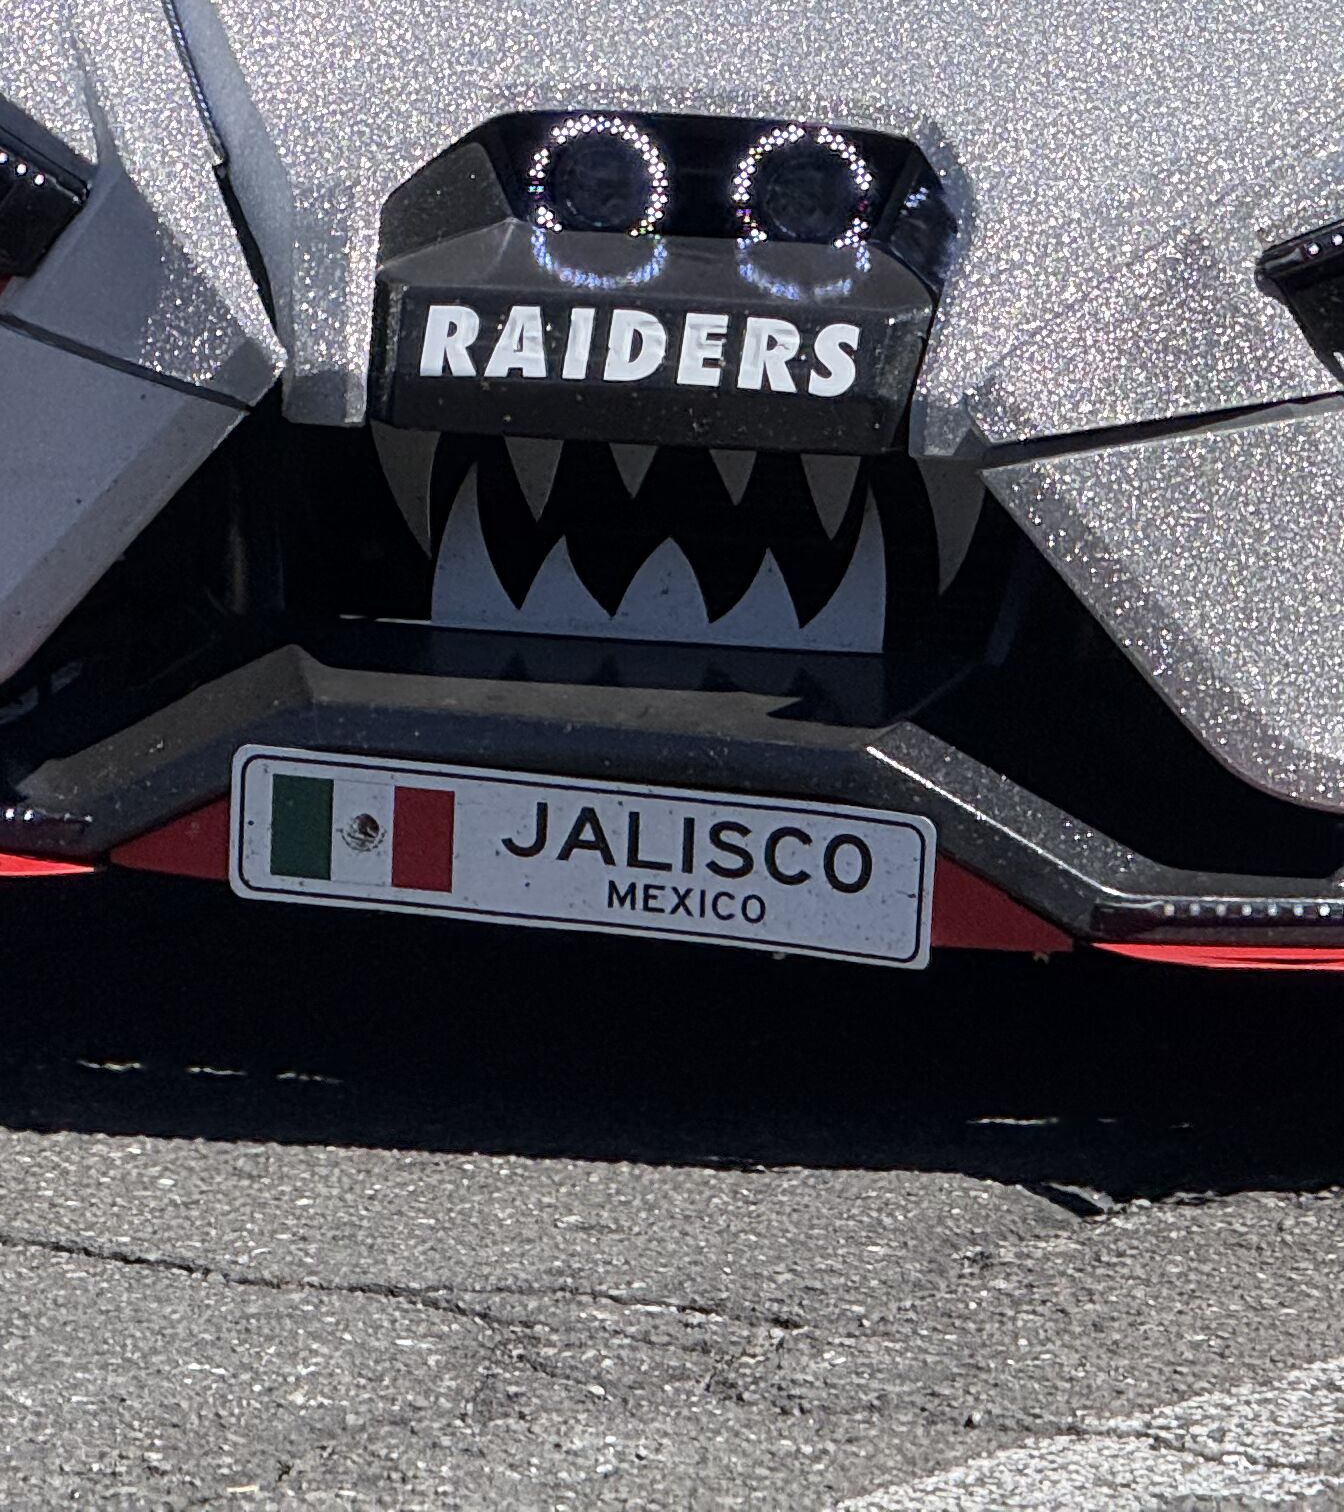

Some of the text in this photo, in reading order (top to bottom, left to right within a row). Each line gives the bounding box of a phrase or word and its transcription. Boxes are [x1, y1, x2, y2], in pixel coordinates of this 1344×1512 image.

[418, 304, 862, 399] RAIDERS
[501, 801, 874, 893] JALISCO
[606, 879, 767, 925] MEXICO
